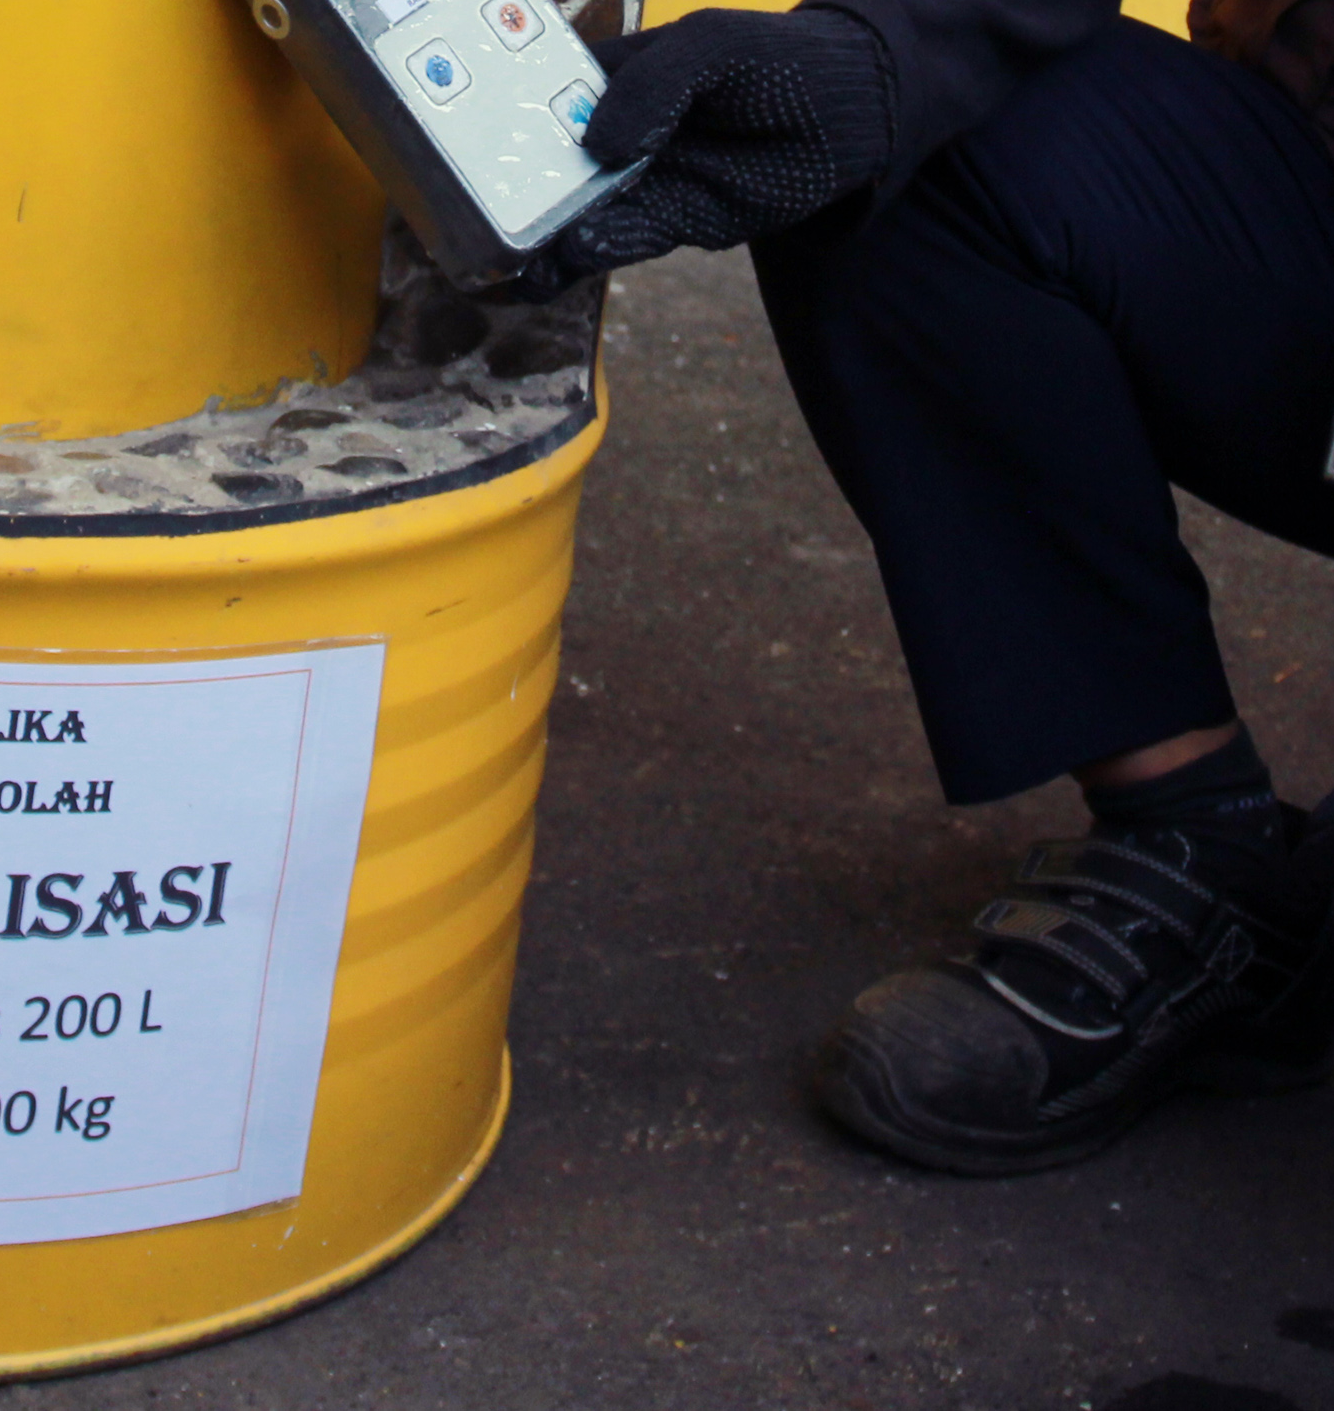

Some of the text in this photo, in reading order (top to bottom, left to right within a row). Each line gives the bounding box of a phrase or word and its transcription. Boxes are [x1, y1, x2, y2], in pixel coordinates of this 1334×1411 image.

[19, 992, 122, 1042] 200
[139, 989, 162, 1033] L
[55, 1085, 116, 1142] kg
